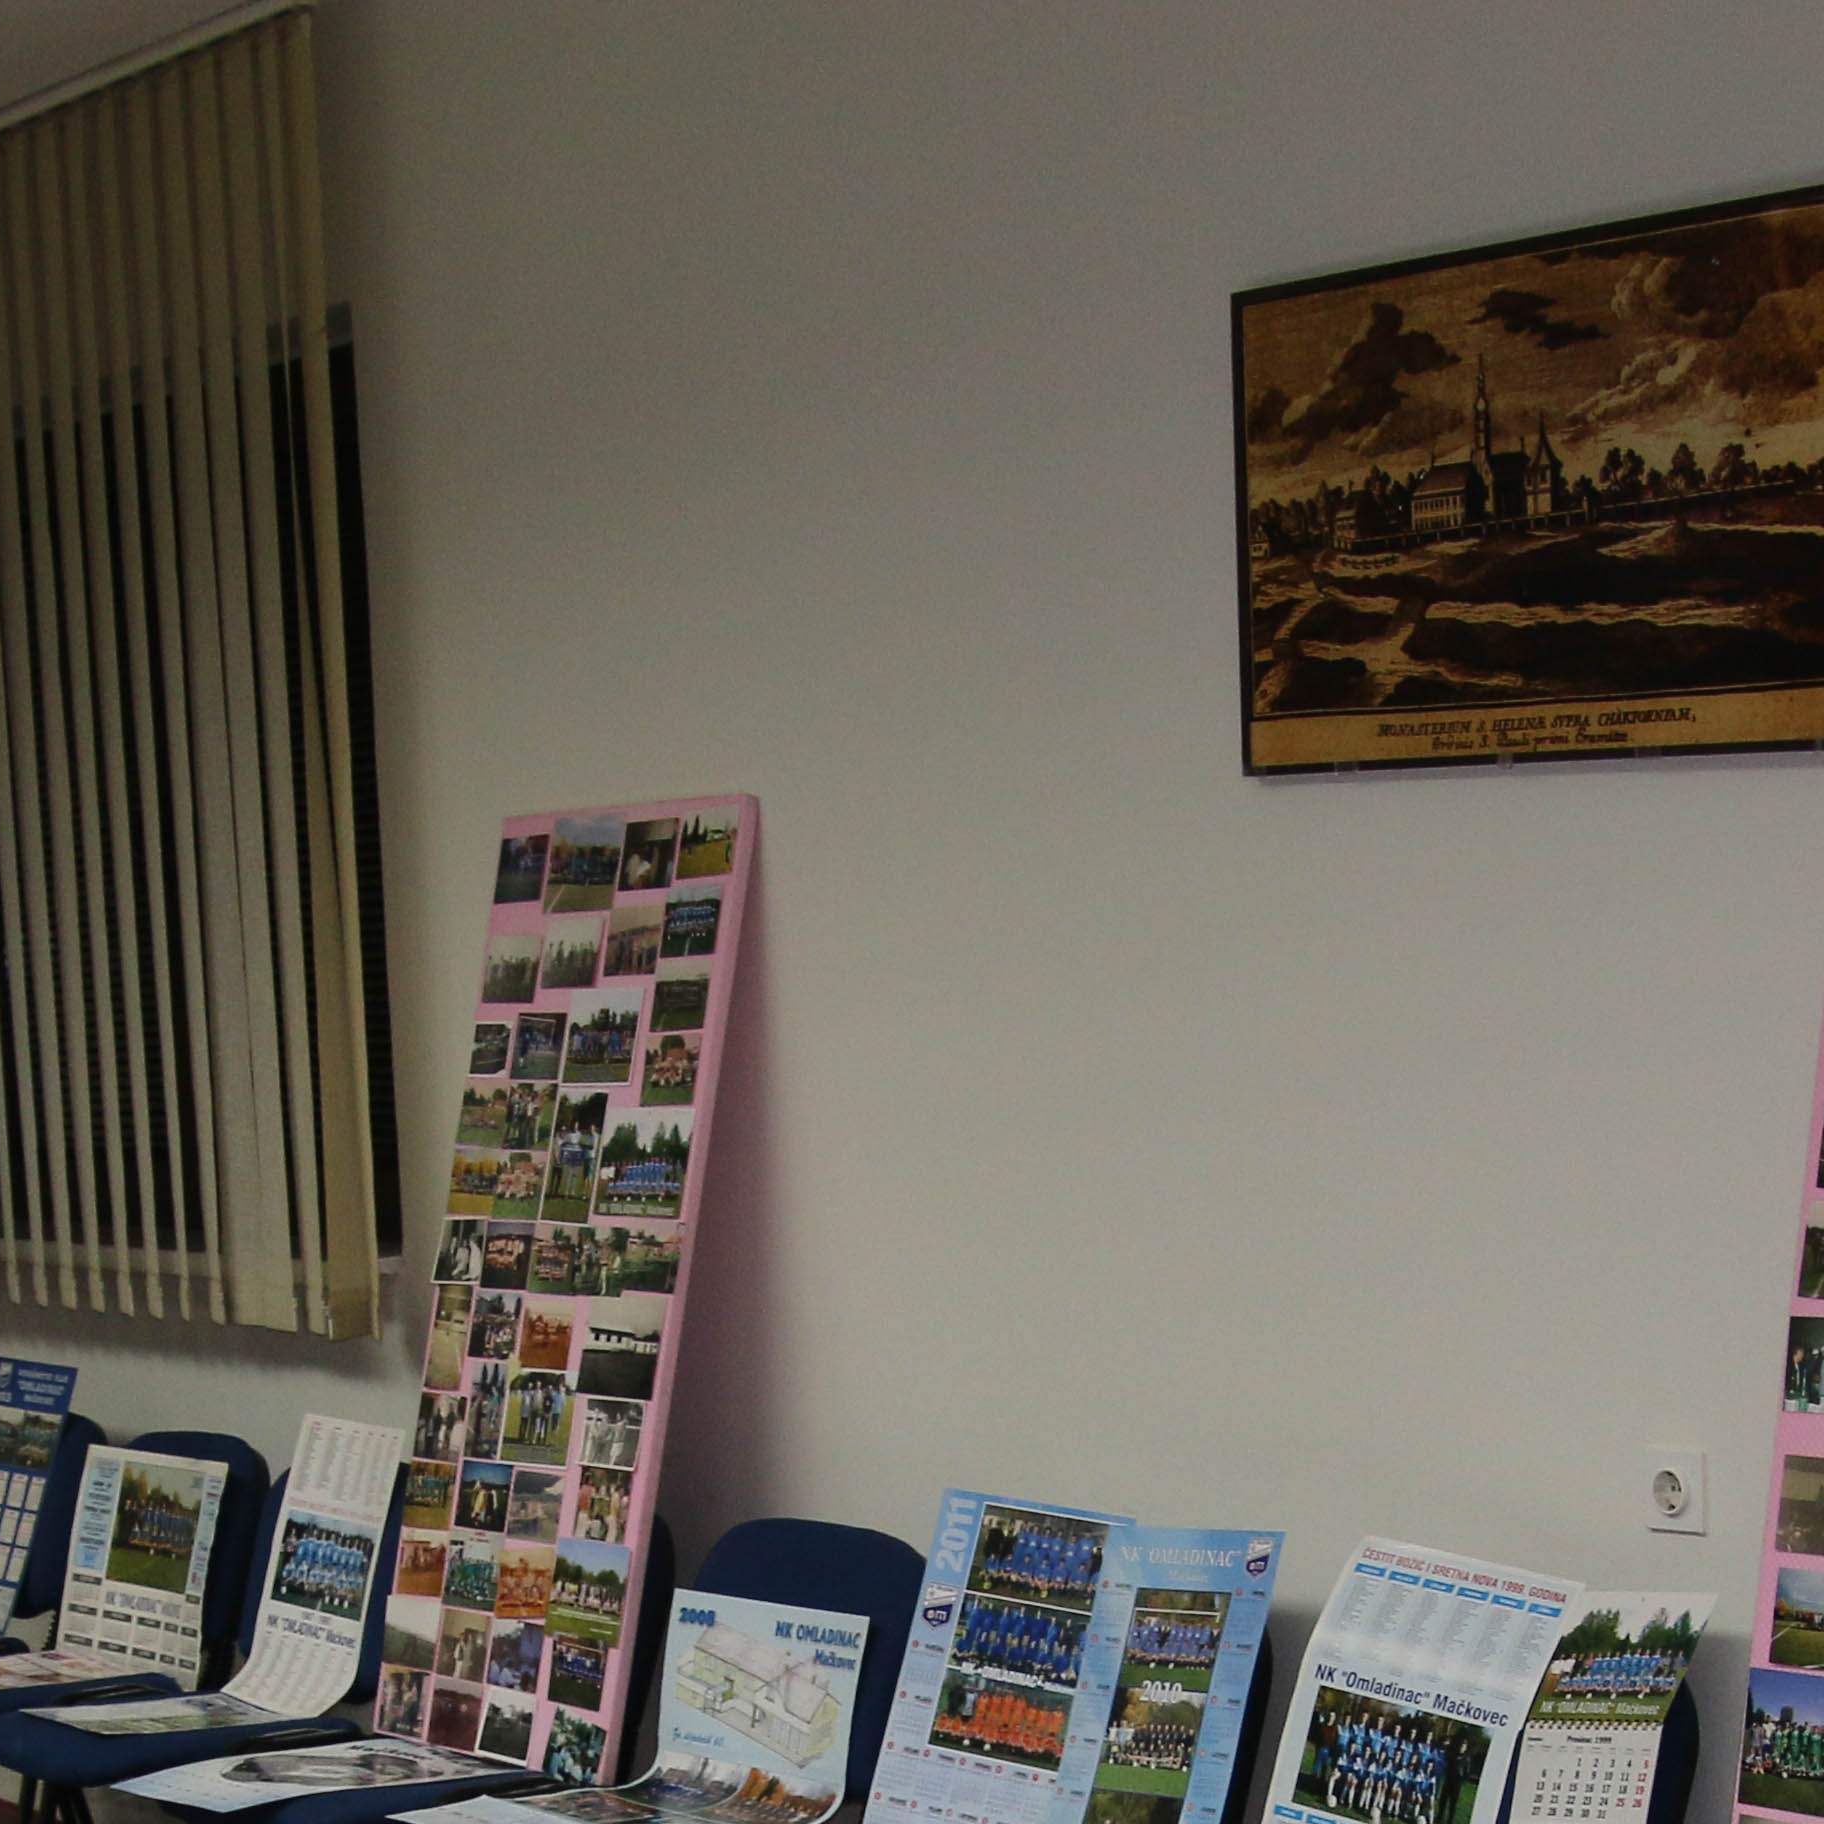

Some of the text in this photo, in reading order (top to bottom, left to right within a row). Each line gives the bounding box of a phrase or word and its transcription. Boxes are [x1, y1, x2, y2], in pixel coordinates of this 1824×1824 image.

[935, 1497, 977, 1572] 2011
[1120, 1547, 1141, 1561] NK
[1432, 1564, 1469, 1581] SRETNA
[1474, 1573, 1498, 1587] NOVA
[1528, 1586, 1566, 1603] GODINA
[326, 1630, 355, 1648] Mačkovec
[776, 1621, 860, 1648] NK OMLADINAC
[814, 1650, 856, 1670] Mačkovec
[1140, 1680, 1182, 1703] 2010
[1316, 1664, 1509, 1727] NK "Omladinac" Mačkovec
[1540, 1701, 1554, 1712] NK
[1617, 1703, 1660, 1715] Mačkovec
[1595, 1736, 1611, 1744] 1999
